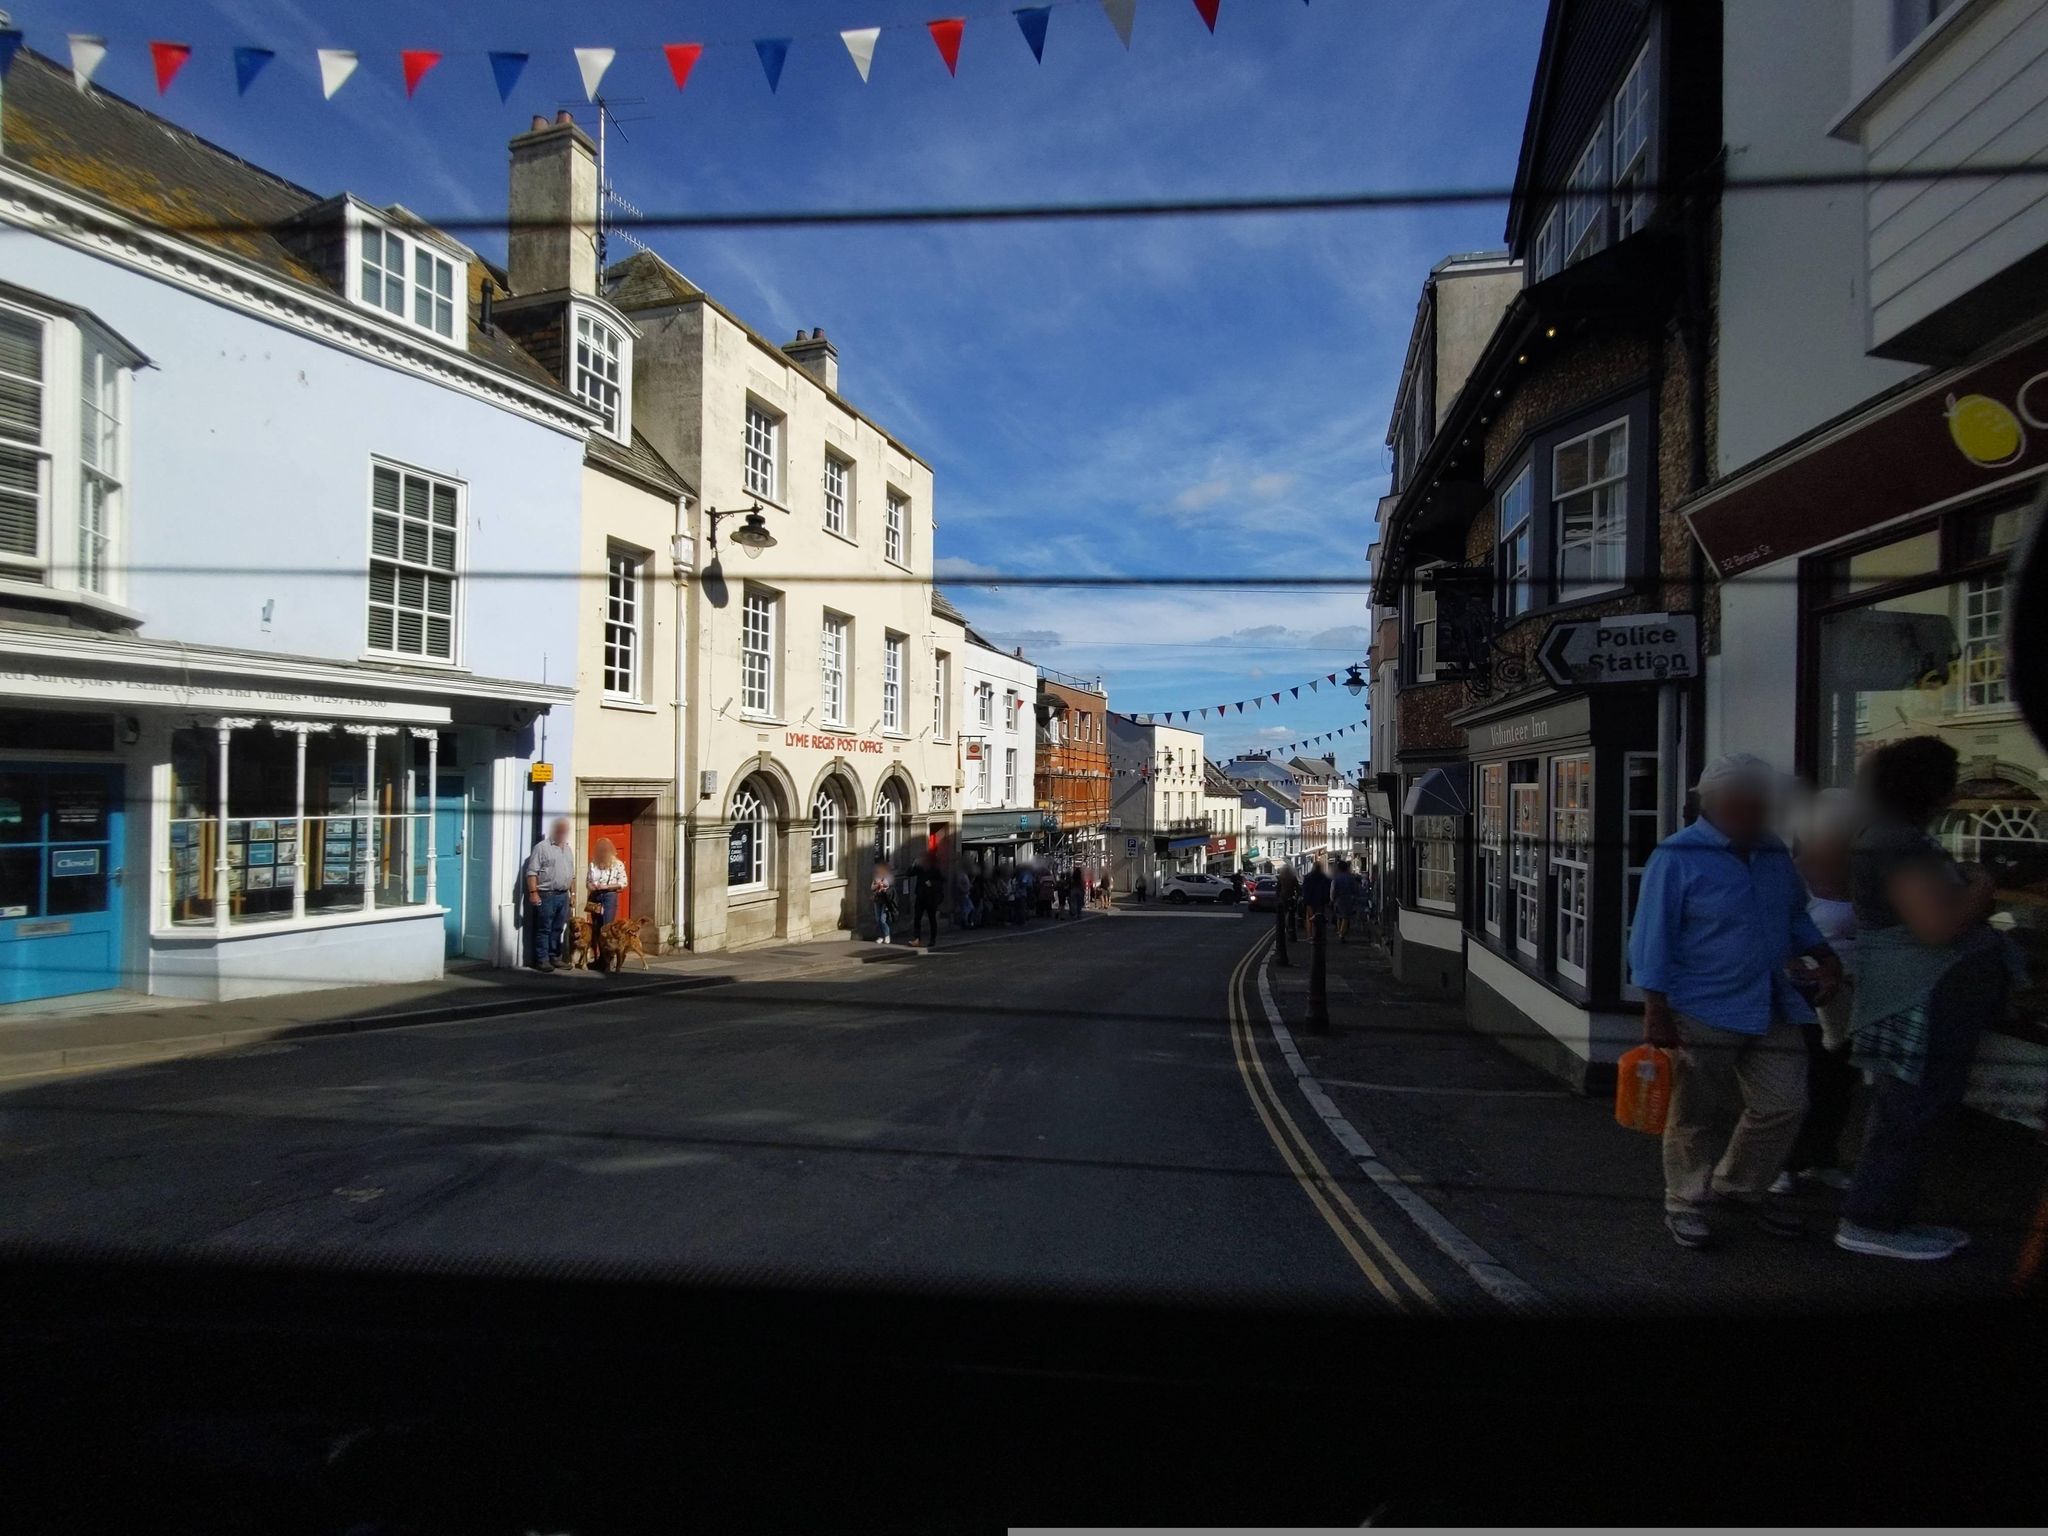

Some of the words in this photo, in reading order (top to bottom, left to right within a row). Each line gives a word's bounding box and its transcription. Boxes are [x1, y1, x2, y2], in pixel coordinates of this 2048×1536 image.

[1721, 558, 1735, 570] 32
[1733, 547, 1760, 566] Broad
[1596, 626, 1677, 649] Police
[1588, 652, 1687, 672] Station
[1490, 724, 1528, 746] Volunteer
[1531, 716, 1548, 738] Inn
[785, 732, 809, 748] LYME
[811, 735, 835, 750] REGIS
[837, 738, 858, 752] POST
[859, 740, 884, 754] OFFICE
[56, 858, 95, 868] Closed
